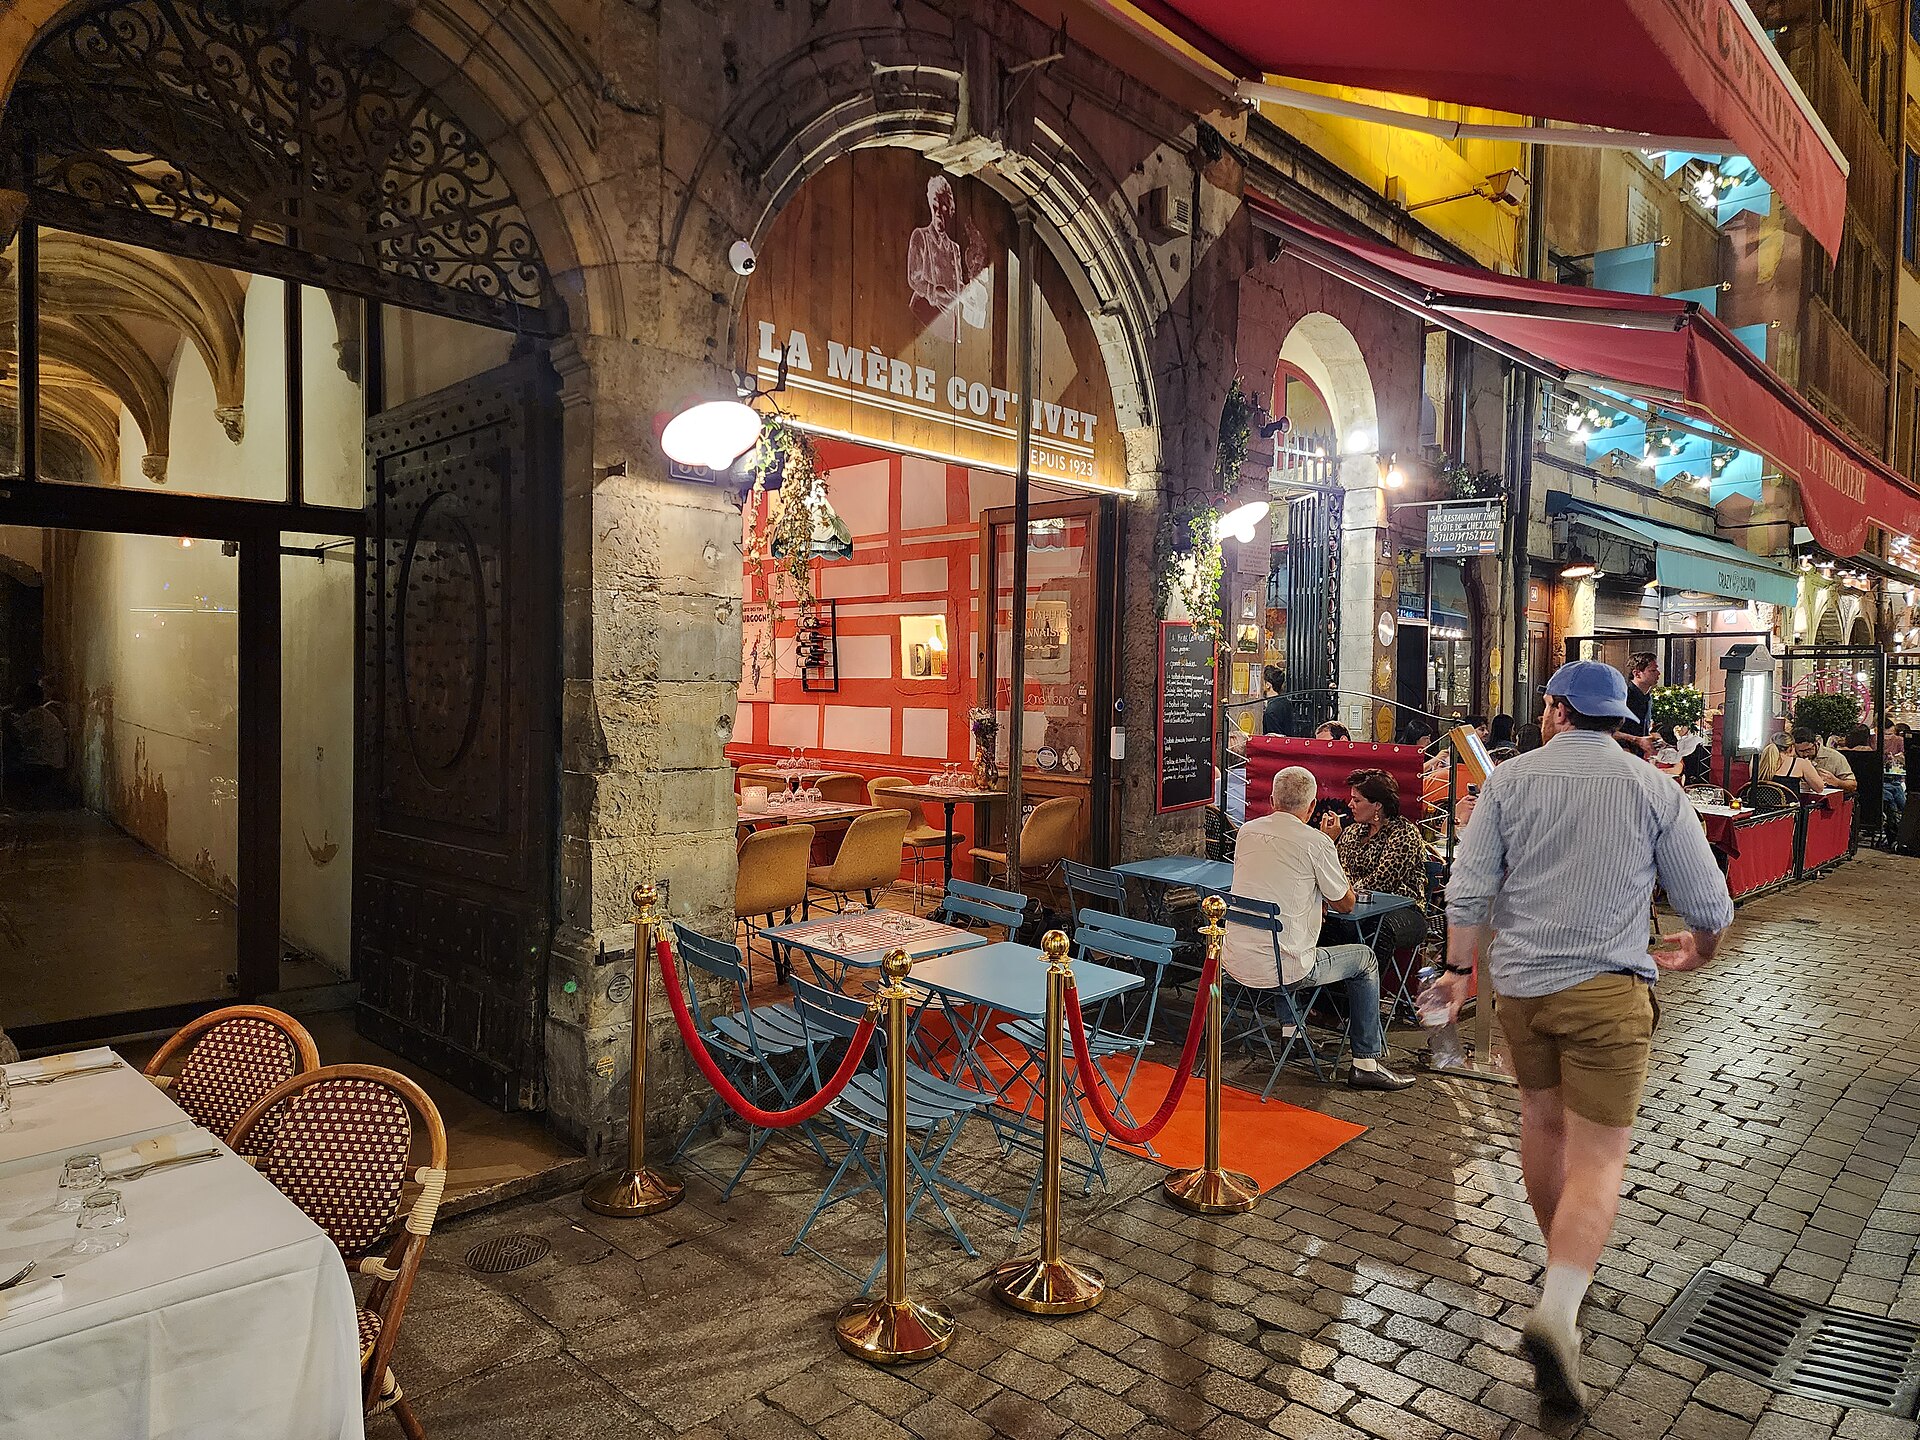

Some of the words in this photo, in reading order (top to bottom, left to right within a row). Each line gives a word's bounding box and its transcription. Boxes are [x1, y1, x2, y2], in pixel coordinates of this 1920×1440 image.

[758, 320, 813, 371] LA
[827, 340, 936, 404] MÈRE
[1031, 449, 1066, 471] EPUIS
[1069, 458, 1093, 477] 1923
[1805, 431, 1818, 475] LE
[1430, 515, 1443, 523] BAR
[1443, 512, 1483, 523] RESTAURANT
[1466, 522, 1484, 530] CHEZ
